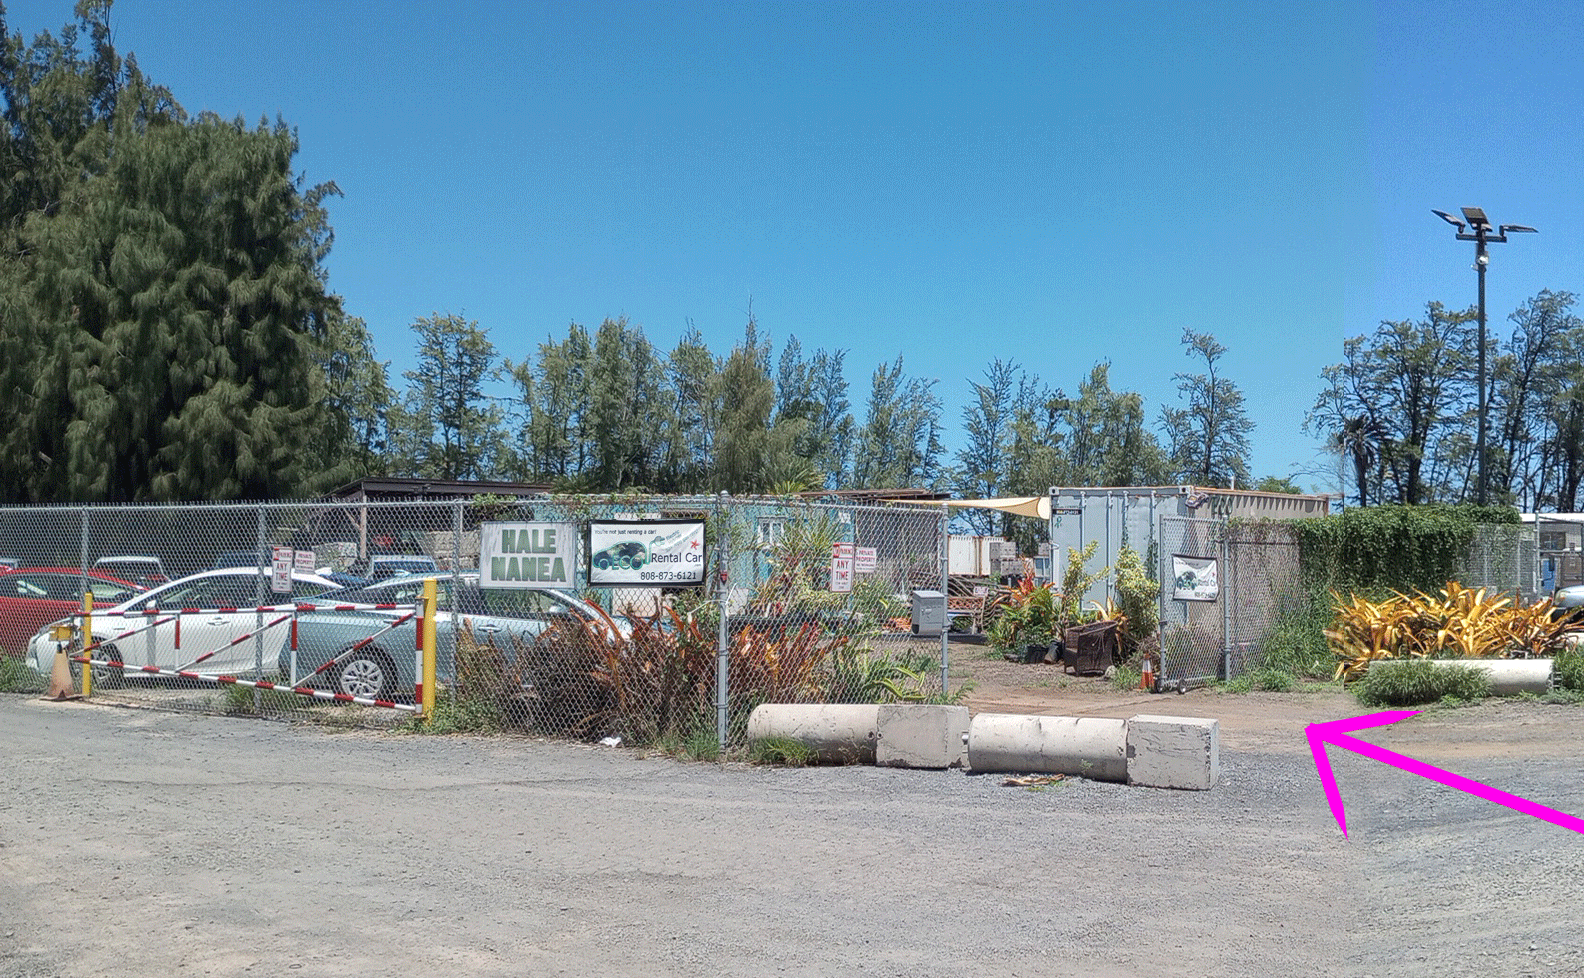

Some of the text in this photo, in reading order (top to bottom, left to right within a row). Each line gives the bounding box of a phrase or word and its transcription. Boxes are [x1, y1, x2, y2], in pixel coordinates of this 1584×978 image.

[502, 529, 556, 554] HALE
[276, 562, 288, 571] ANY
[612, 553, 702, 570] ECO Rental Car
[836, 560, 849, 569] ANY
[491, 556, 567, 582] NANEA
[275, 572, 288, 581] TIME
[640, 571, 697, 581] 808-873-6121
[835, 571, 849, 581] TIME
